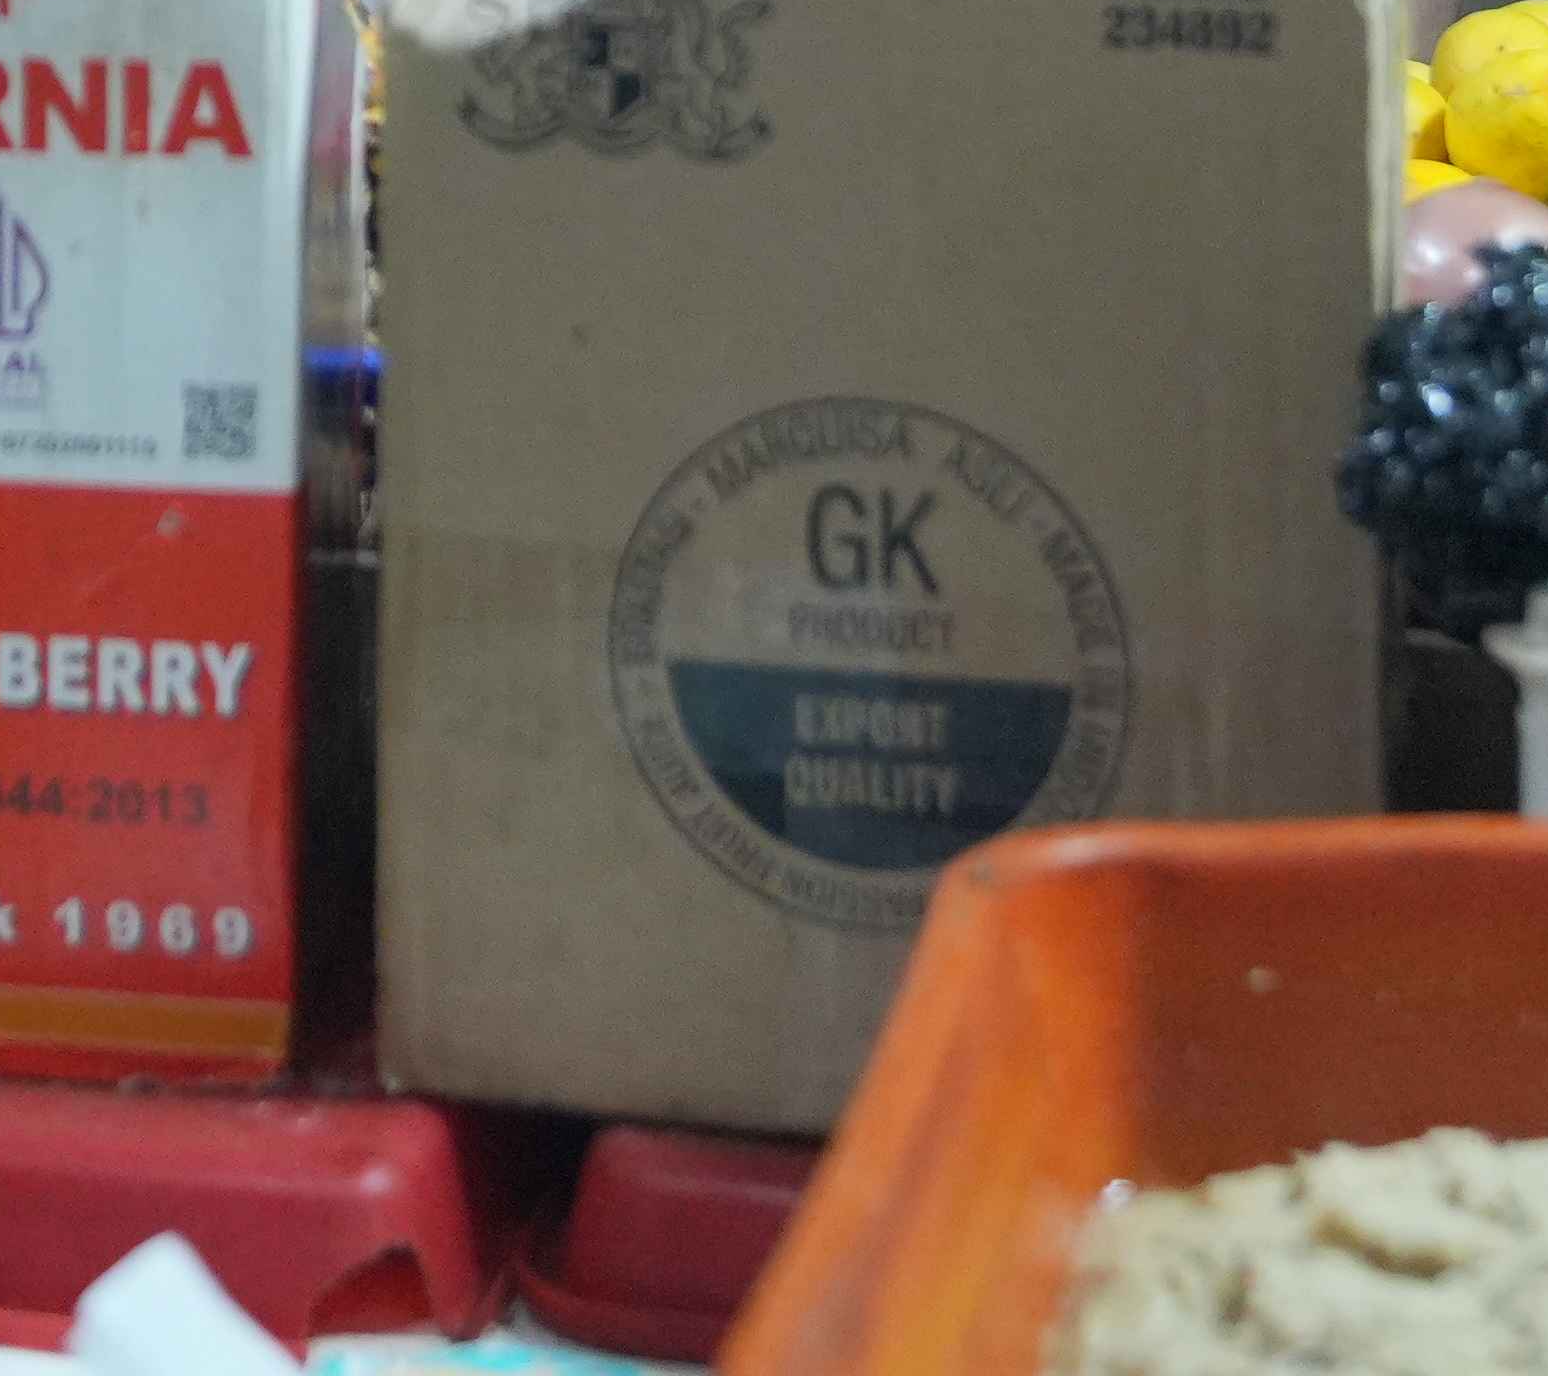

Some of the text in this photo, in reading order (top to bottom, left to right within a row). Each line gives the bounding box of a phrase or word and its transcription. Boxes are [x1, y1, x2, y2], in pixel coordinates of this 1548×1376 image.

[808, 482, 939, 595] GK
[783, 755, 960, 816] QUALITY
[54, 895, 255, 957] 1969
